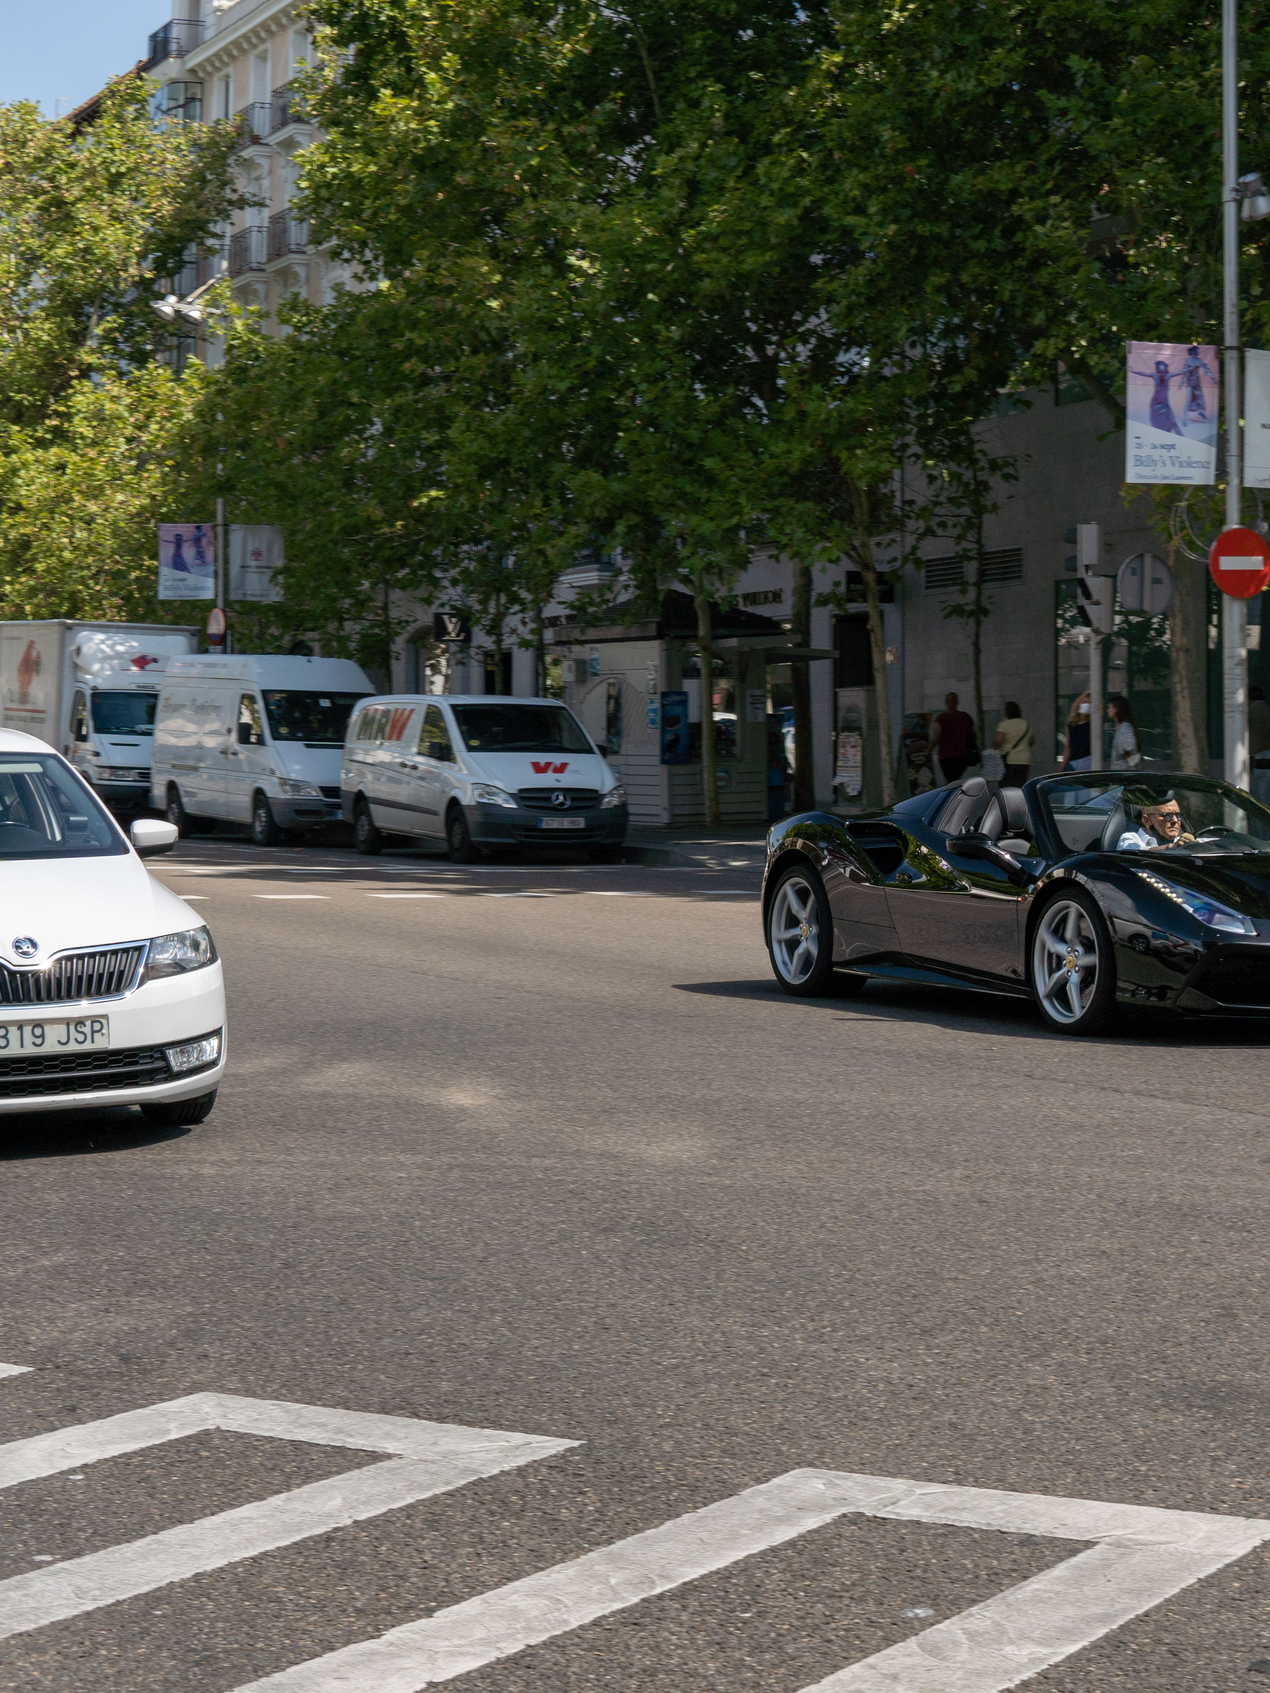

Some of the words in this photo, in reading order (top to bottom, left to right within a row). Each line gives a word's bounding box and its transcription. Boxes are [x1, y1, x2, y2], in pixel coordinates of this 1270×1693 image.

[1133, 454, 1167, 472] Billy's
[357, 708, 415, 741] MRW
[57, 1019, 104, 1046] JSP
